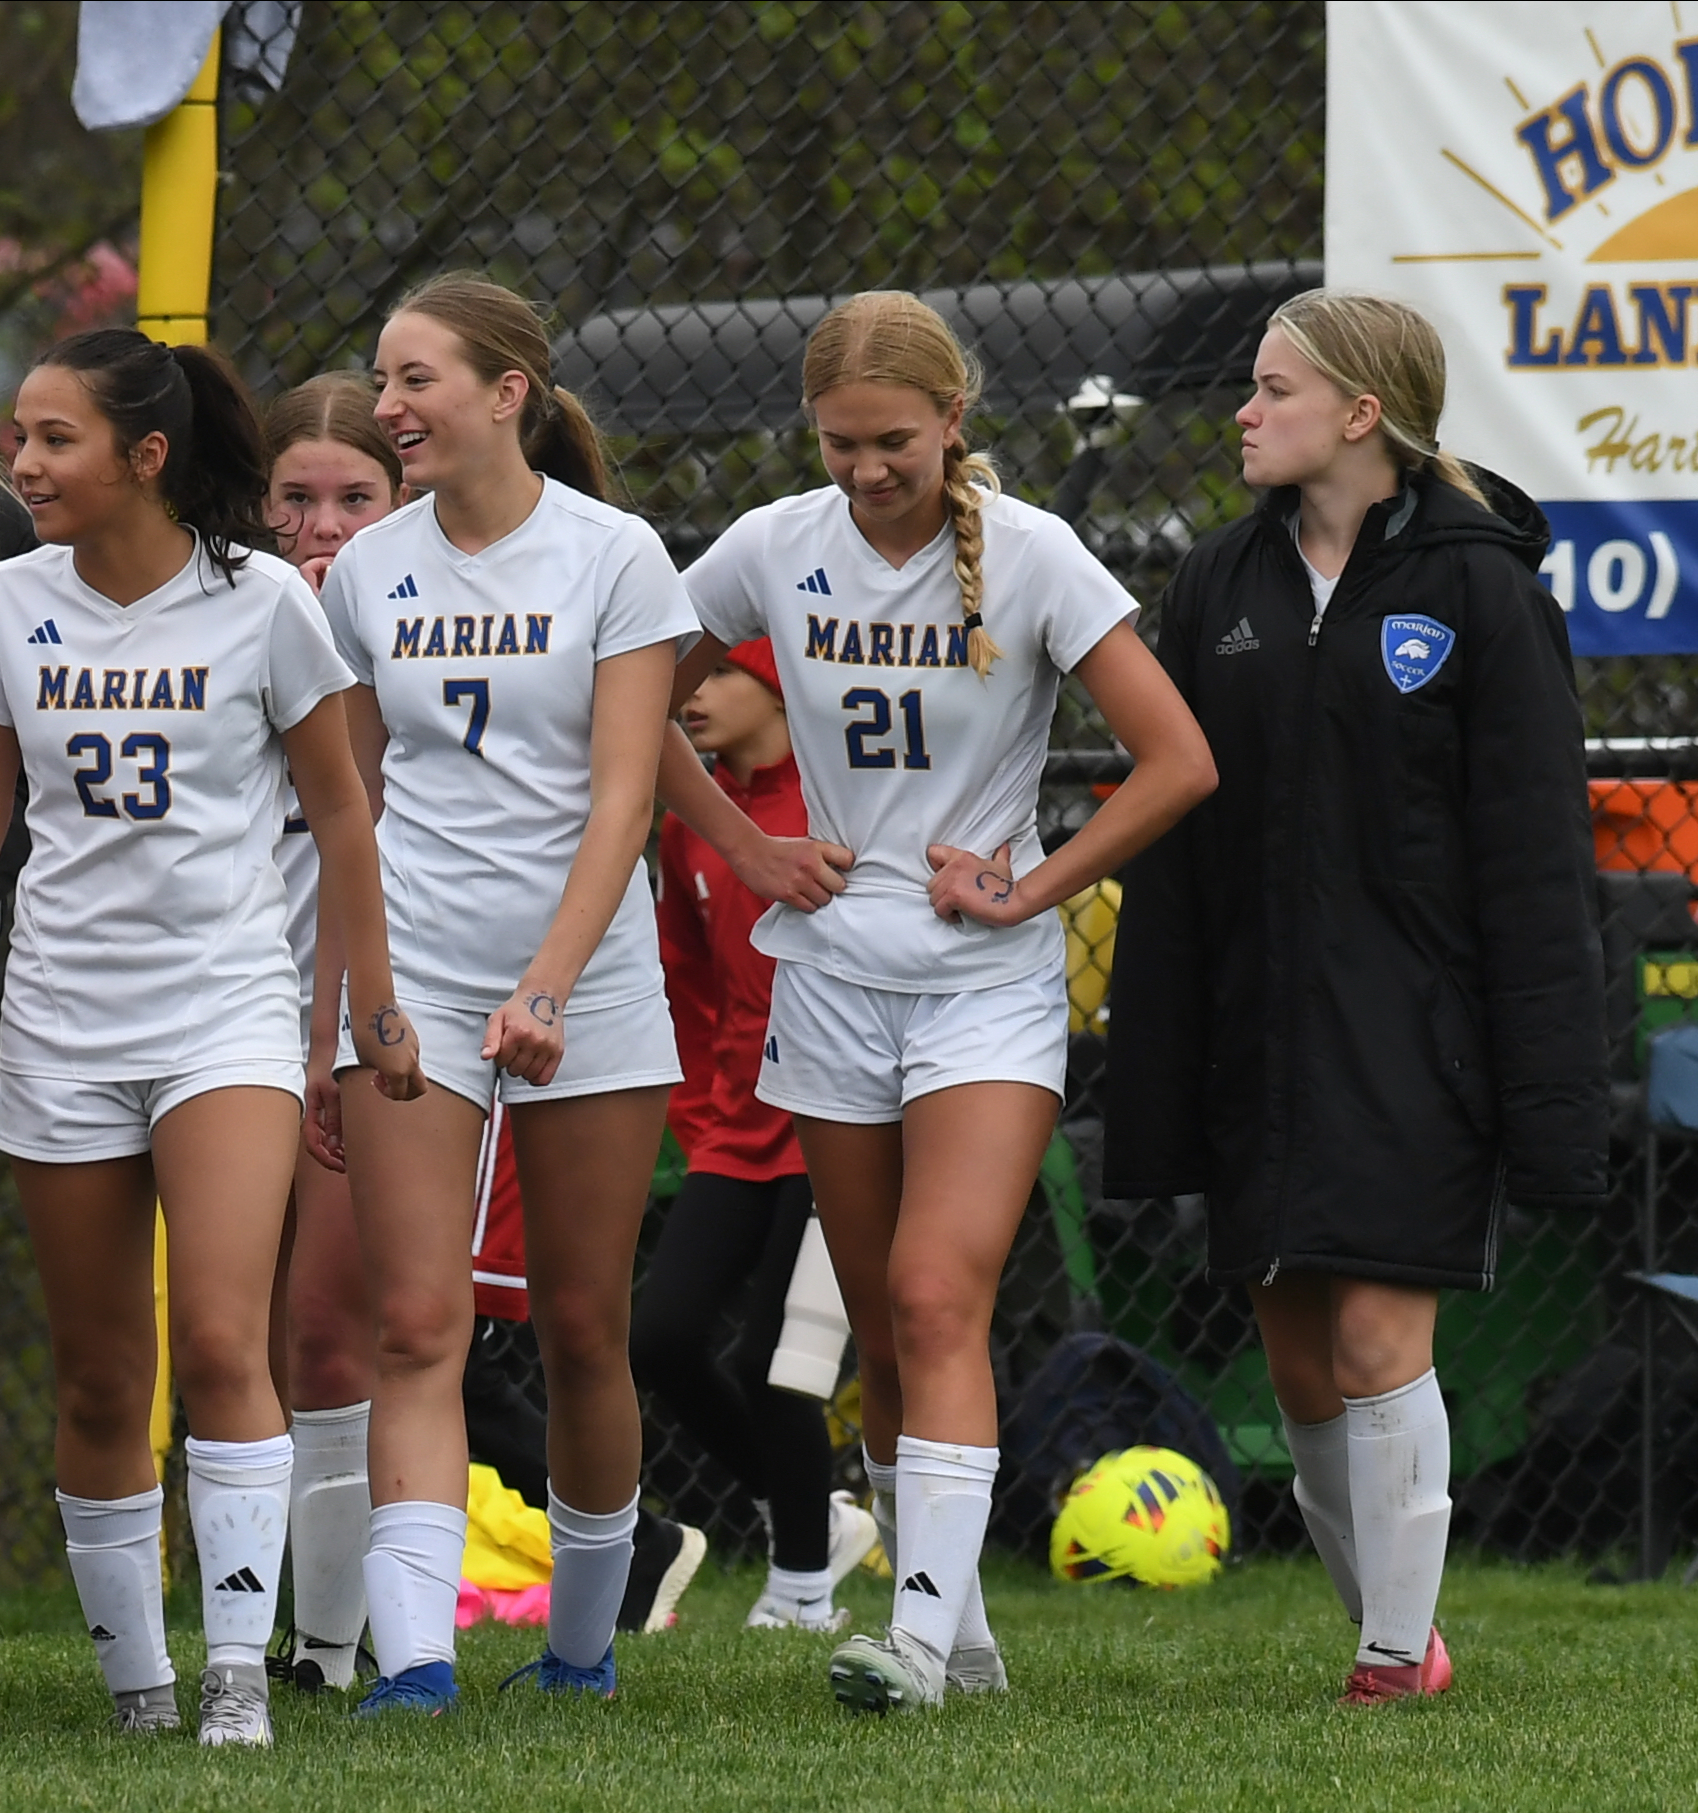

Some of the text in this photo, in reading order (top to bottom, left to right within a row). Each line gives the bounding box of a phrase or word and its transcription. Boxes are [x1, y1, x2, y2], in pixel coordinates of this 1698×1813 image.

[1515, 36, 1698, 224] HO
[1502, 278, 1698, 372] LAN
[1578, 406, 1698, 474] Har
[390, 612, 552, 660] MARIAN
[805, 612, 969, 668] MARIAN
[36, 665, 209, 712] MARIAN
[442, 677, 492, 757] 7
[840, 686, 932, 771] 21
[65, 731, 173, 822] 23
